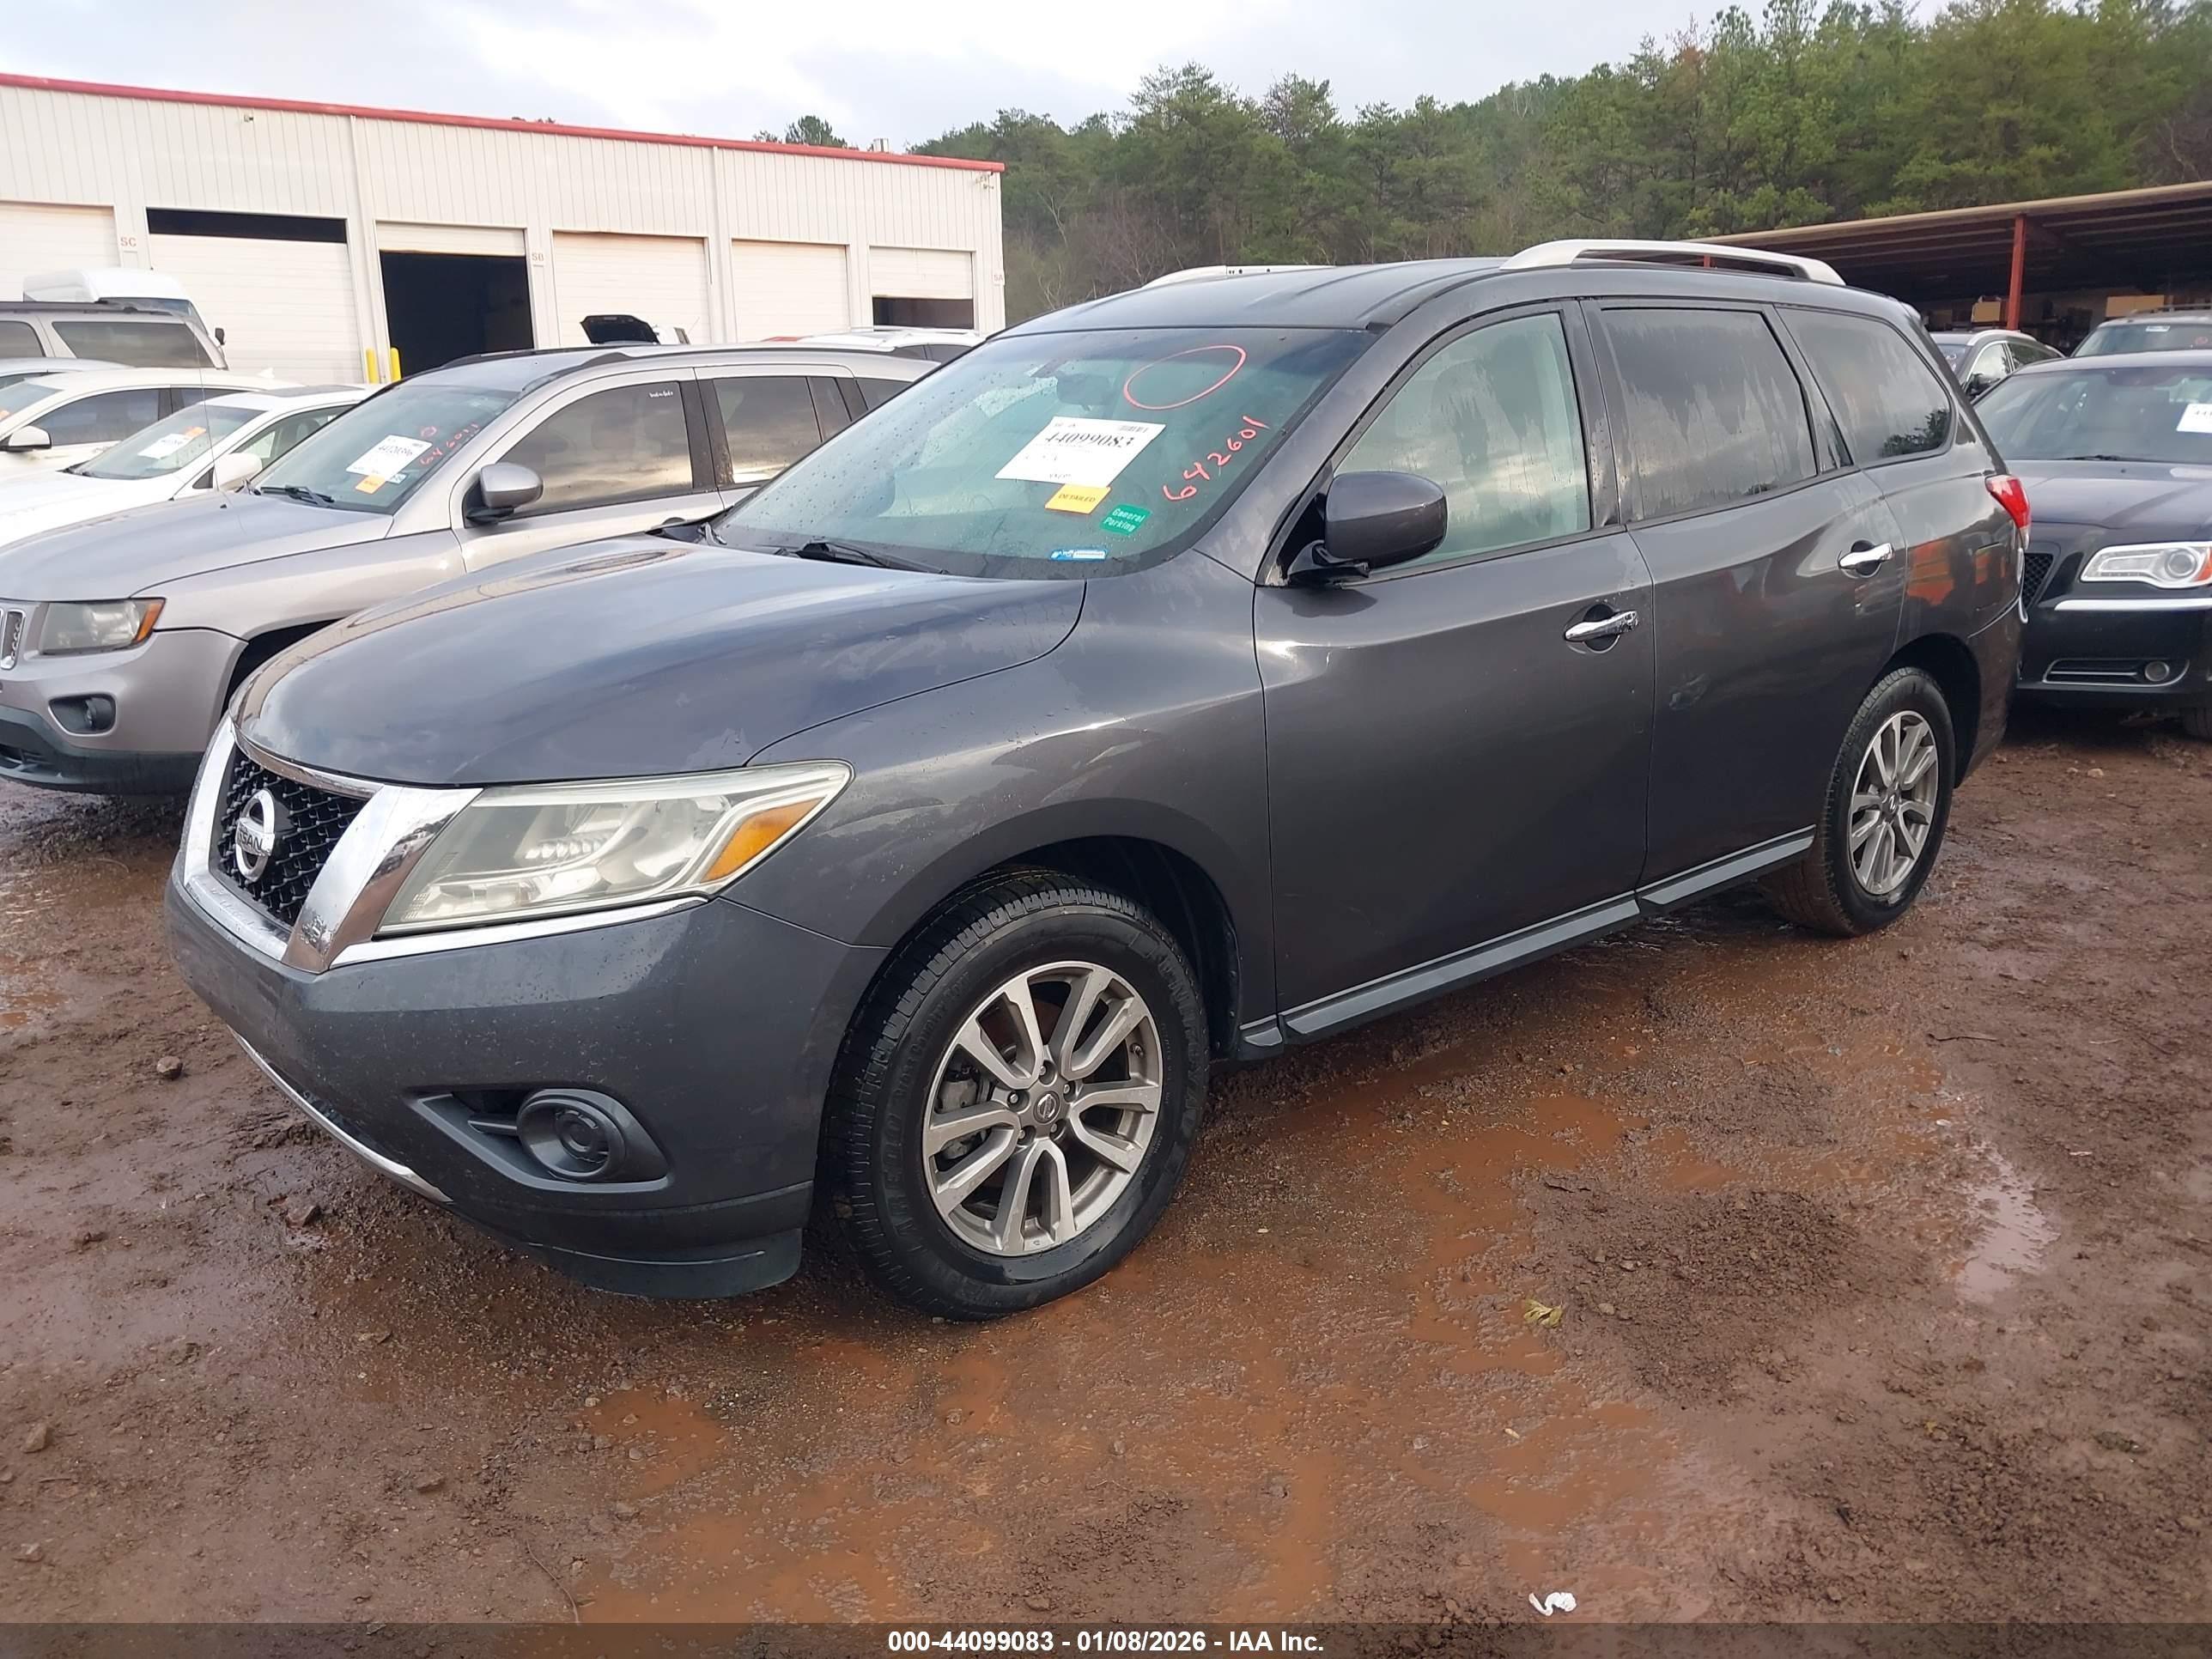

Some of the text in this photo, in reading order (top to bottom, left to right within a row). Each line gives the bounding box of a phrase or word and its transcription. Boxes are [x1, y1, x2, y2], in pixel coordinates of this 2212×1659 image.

[1163, 416, 1270, 500] 642601
[1112, 507, 1146, 523] General
[1103, 517, 1136, 532] Parking
